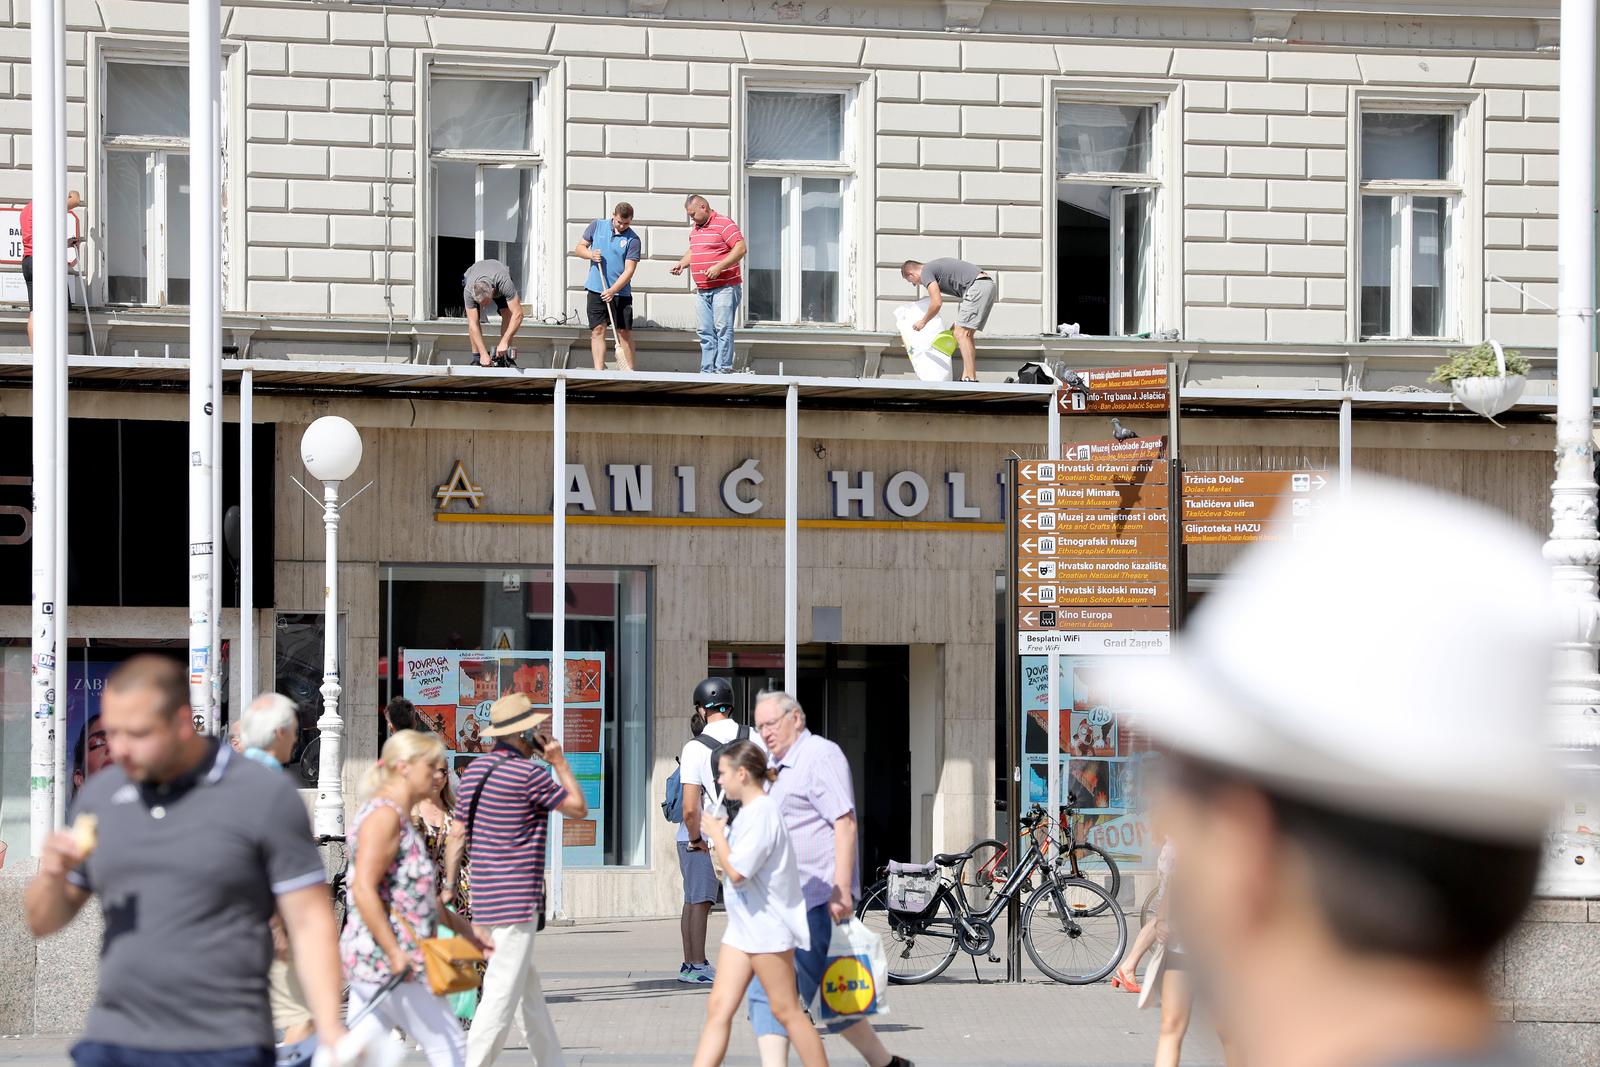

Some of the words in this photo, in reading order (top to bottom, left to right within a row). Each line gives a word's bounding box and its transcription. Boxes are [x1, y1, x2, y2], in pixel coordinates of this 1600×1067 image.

[9, 228, 23, 236] BA
[1103, 393, 1114, 402] Trg
[1115, 392, 1132, 401] bana
[1132, 392, 1139, 400] J.
[1140, 391, 1166, 401] Jelačića
[1112, 403, 1127, 411] Josip
[1146, 402, 1165, 410] Square
[1091, 445, 1110, 454] Muzej
[1111, 443, 1140, 452] čokolade
[1141, 440, 1163, 450] Zagreb
[1057, 463, 1094, 472] Hrvatski
[1096, 463, 1129, 472] državni
[1131, 463, 1154, 472] arhiv
[1184, 475, 1217, 484] Tržnica
[1218, 475, 1244, 484] Dolac
[1057, 488, 1084, 498] Muzej
[1086, 488, 1120, 497] Mimara
[1206, 485, 1232, 493] Market
[1185, 499, 1231, 508] Tkalčićeva
[1233, 499, 1254, 508] ulica
[1057, 512, 1084, 522] Muzej
[1097, 512, 1141, 522] umjetnost
[1185, 524, 1232, 534] Gliptoteka
[1234, 524, 1261, 532] HAZU
[1058, 537, 1108, 547] Etnografski
[1110, 537, 1137, 547] muzej
[1057, 547, 1105, 555] Ethnographic
[1058, 561, 1094, 570] Hrvatsko
[1096, 561, 1130, 570] narodno
[1131, 561, 1167, 570] kazalište
[1058, 586, 1095, 595] Hrvatski
[1097, 585, 1128, 595] školski
[1129, 586, 1157, 596] muzej
[1058, 610, 1079, 619] Kino
[1081, 610, 1113, 620] Europa
[1087, 620, 1113, 629] Europa
[1027, 634, 1062, 644] Besplatni
[1103, 638, 1127, 648] Grad
[1129, 638, 1163, 649] Zagreb
[408, 655, 449, 672] DOVRAGA
[411, 665, 450, 680] ZATVARAJTA
[418, 674, 444, 686] VRATA!
[479, 703, 491, 718] 19
[1091, 706, 1111, 723] 193
